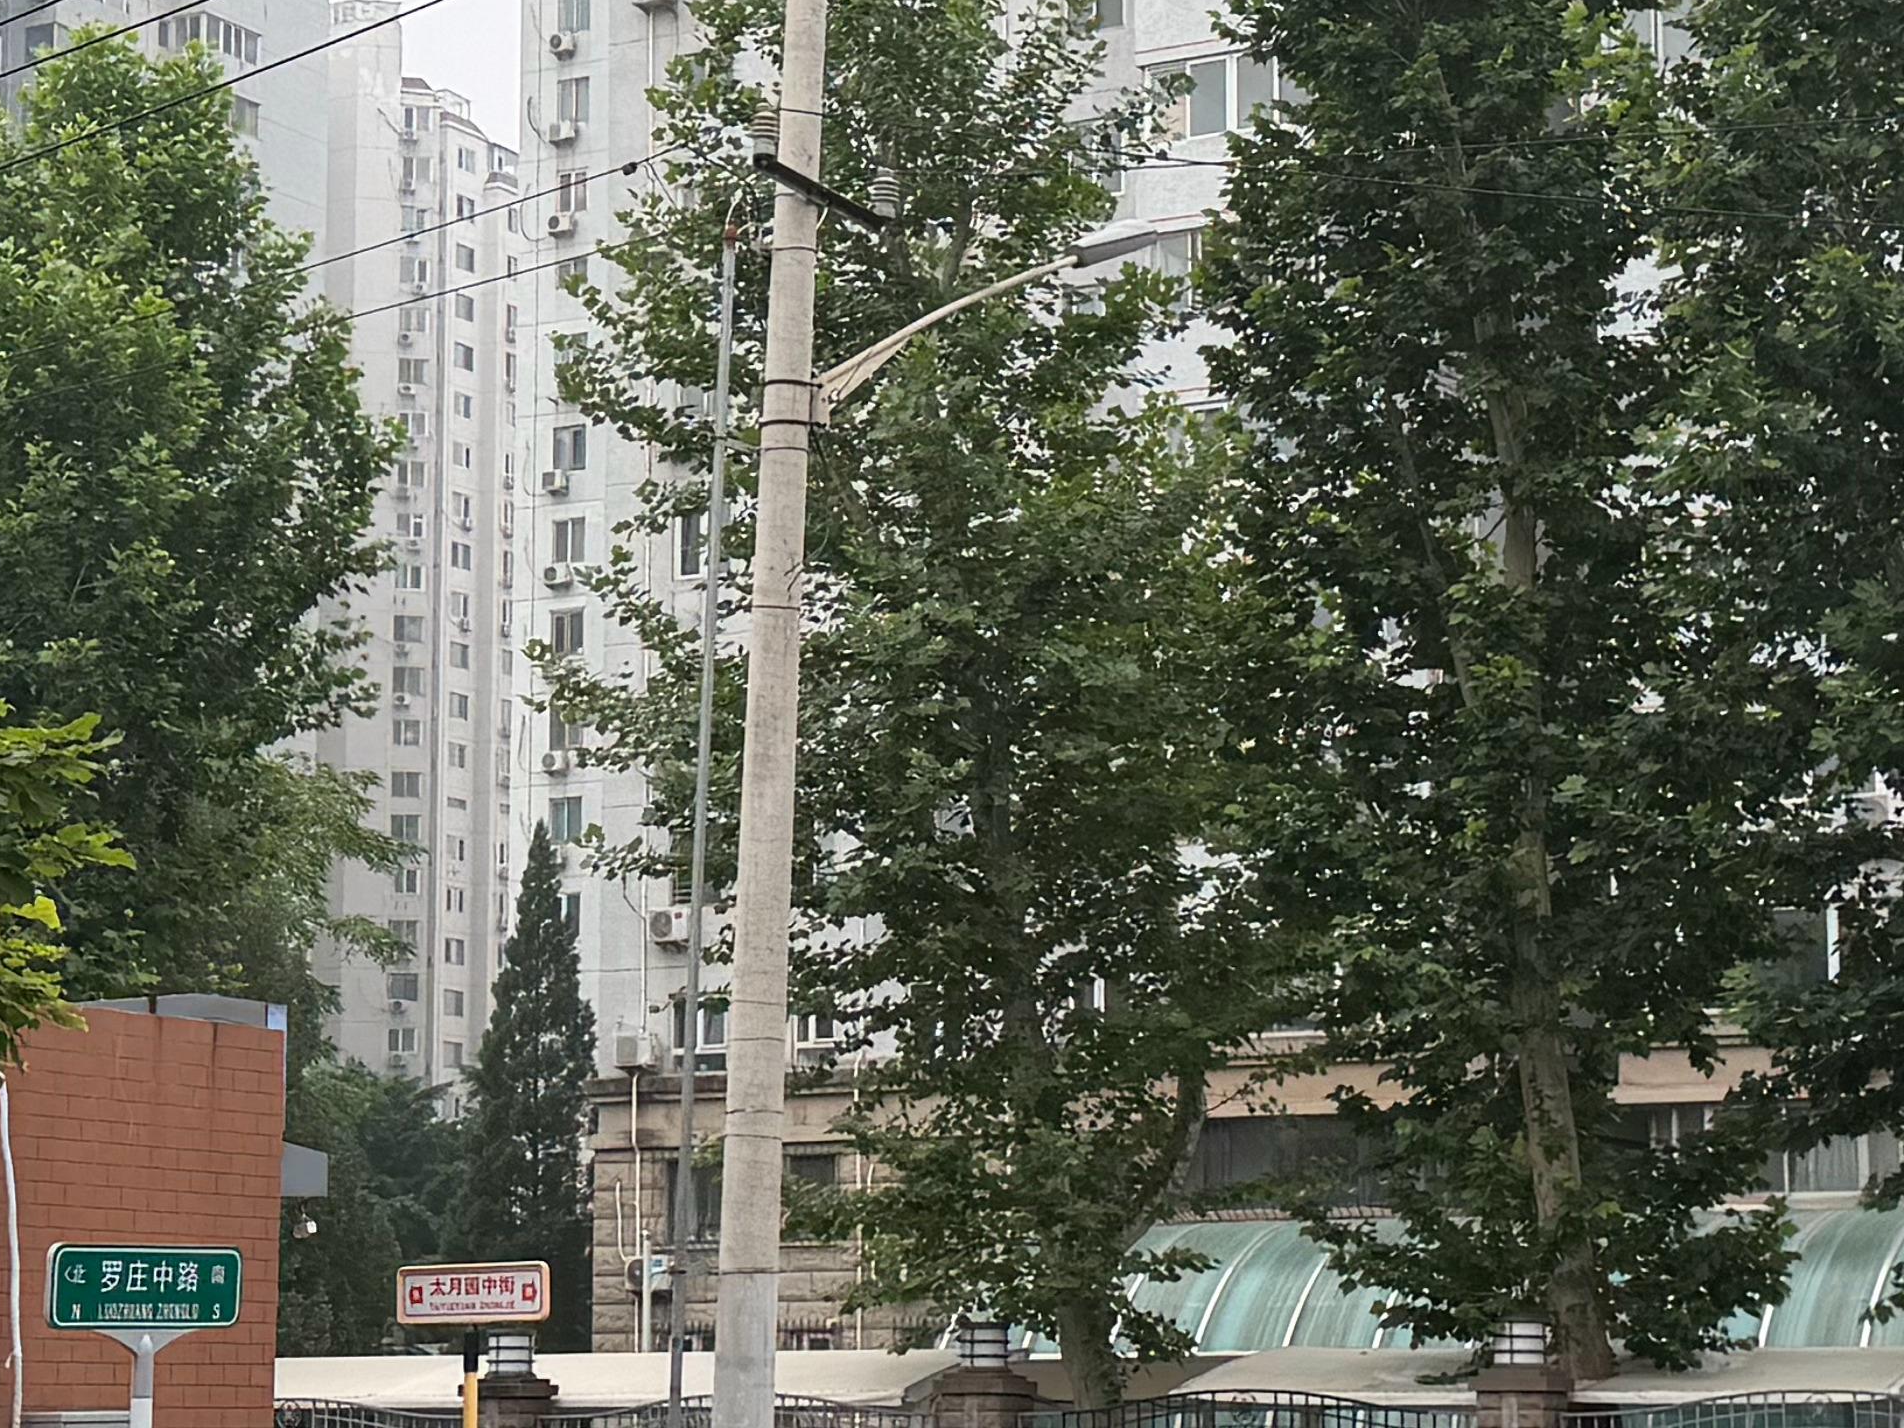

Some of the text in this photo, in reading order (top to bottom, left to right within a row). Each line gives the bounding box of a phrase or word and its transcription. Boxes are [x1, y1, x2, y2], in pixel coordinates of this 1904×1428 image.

[100, 1260, 199, 1293] 罗庄中路
[429, 1275, 516, 1297] 太月园中街
[70, 1303, 81, 1320] N
[212, 1303, 221, 1320] S
